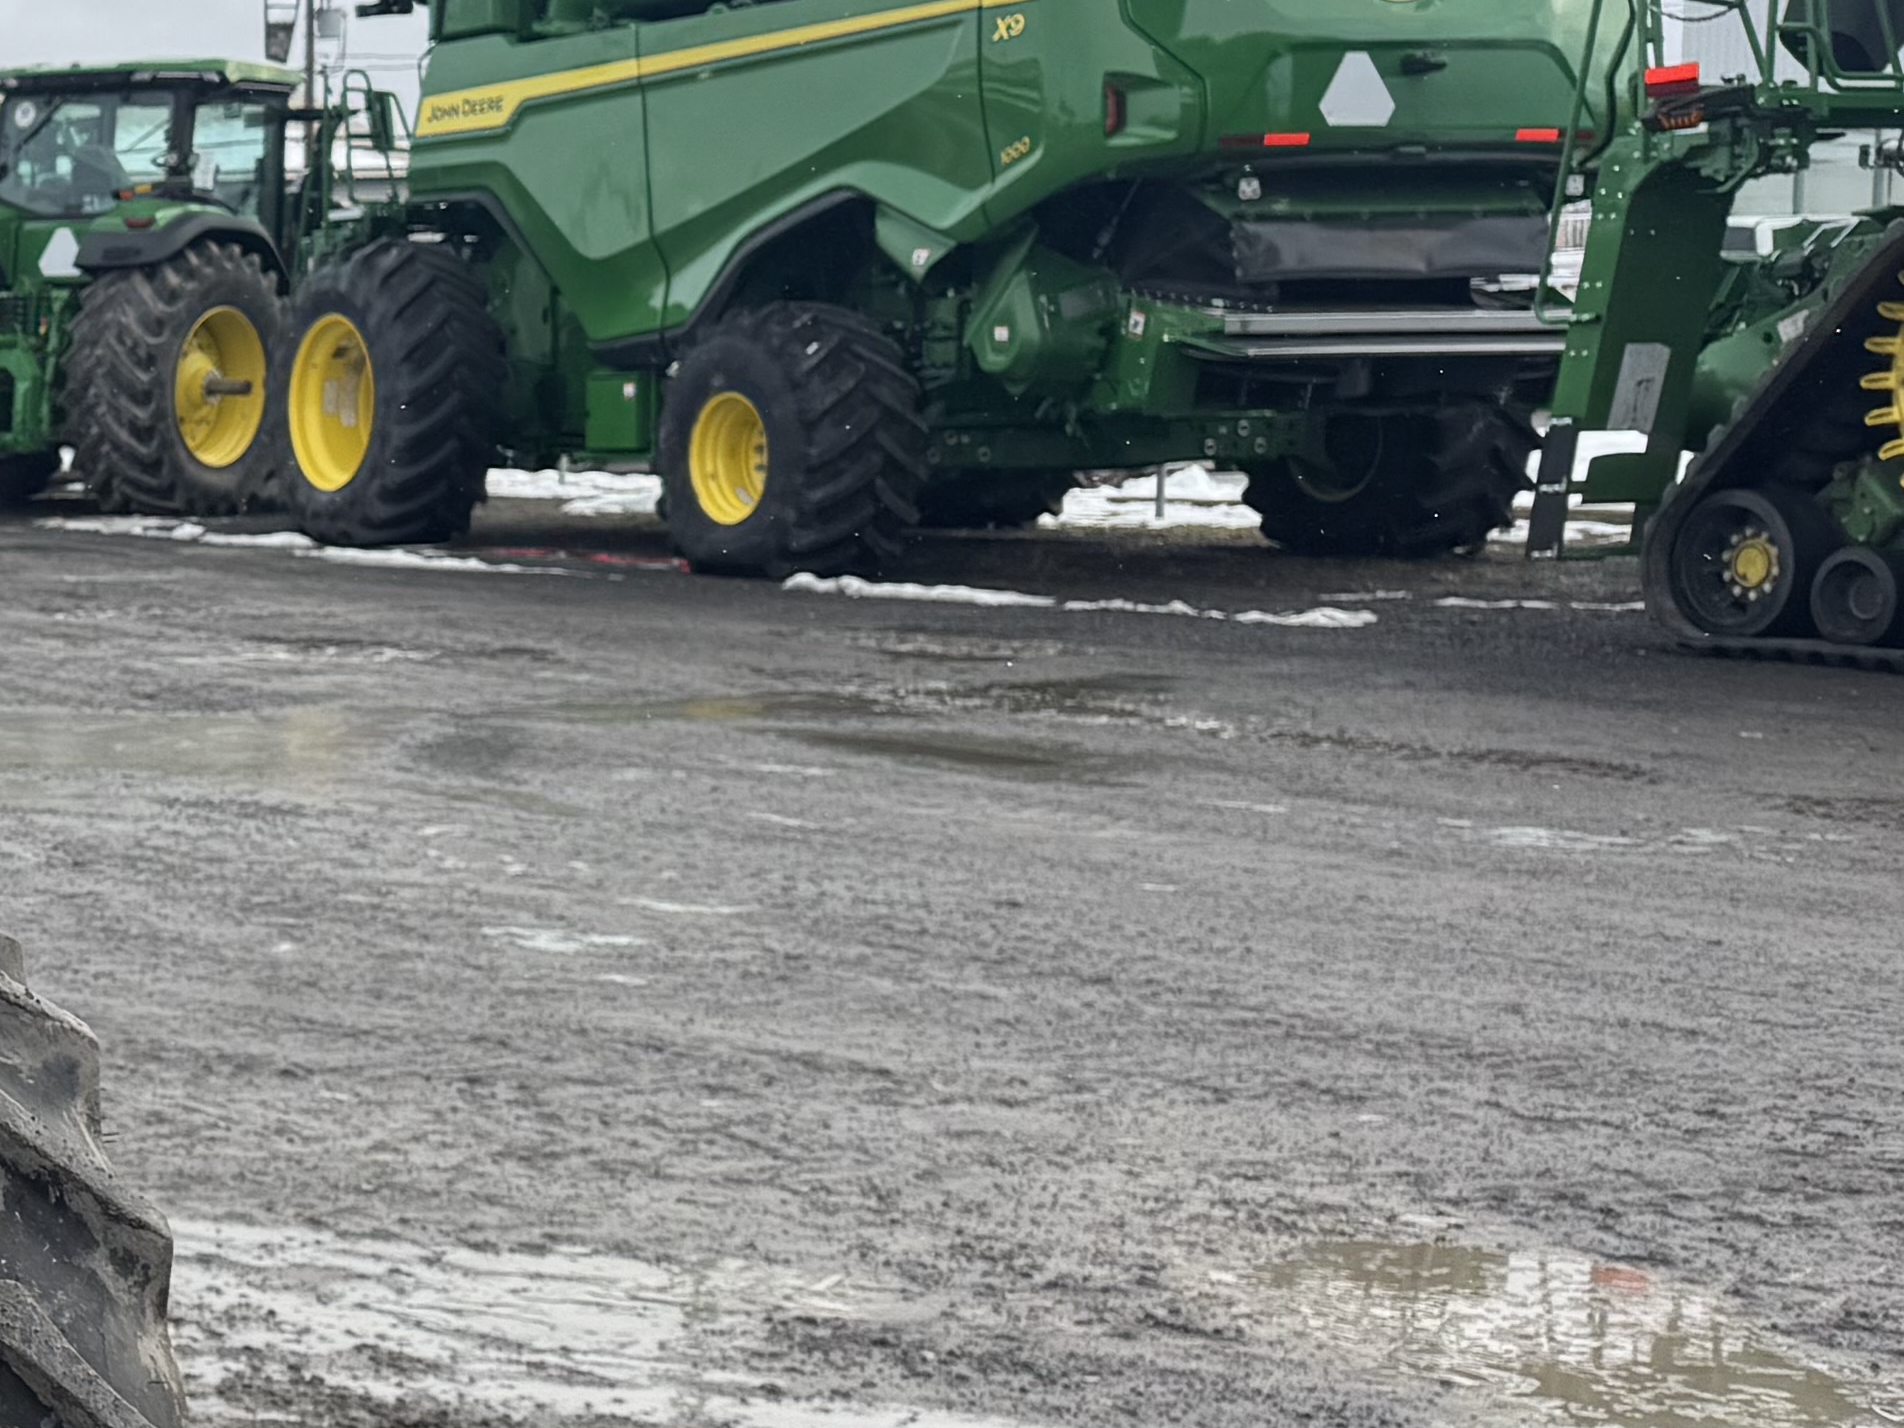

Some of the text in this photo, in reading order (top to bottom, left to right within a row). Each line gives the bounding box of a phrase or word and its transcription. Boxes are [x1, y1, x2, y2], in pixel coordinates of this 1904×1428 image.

[992, 13, 1025, 42] X9
[427, 95, 504, 123] JOHN DEERE
